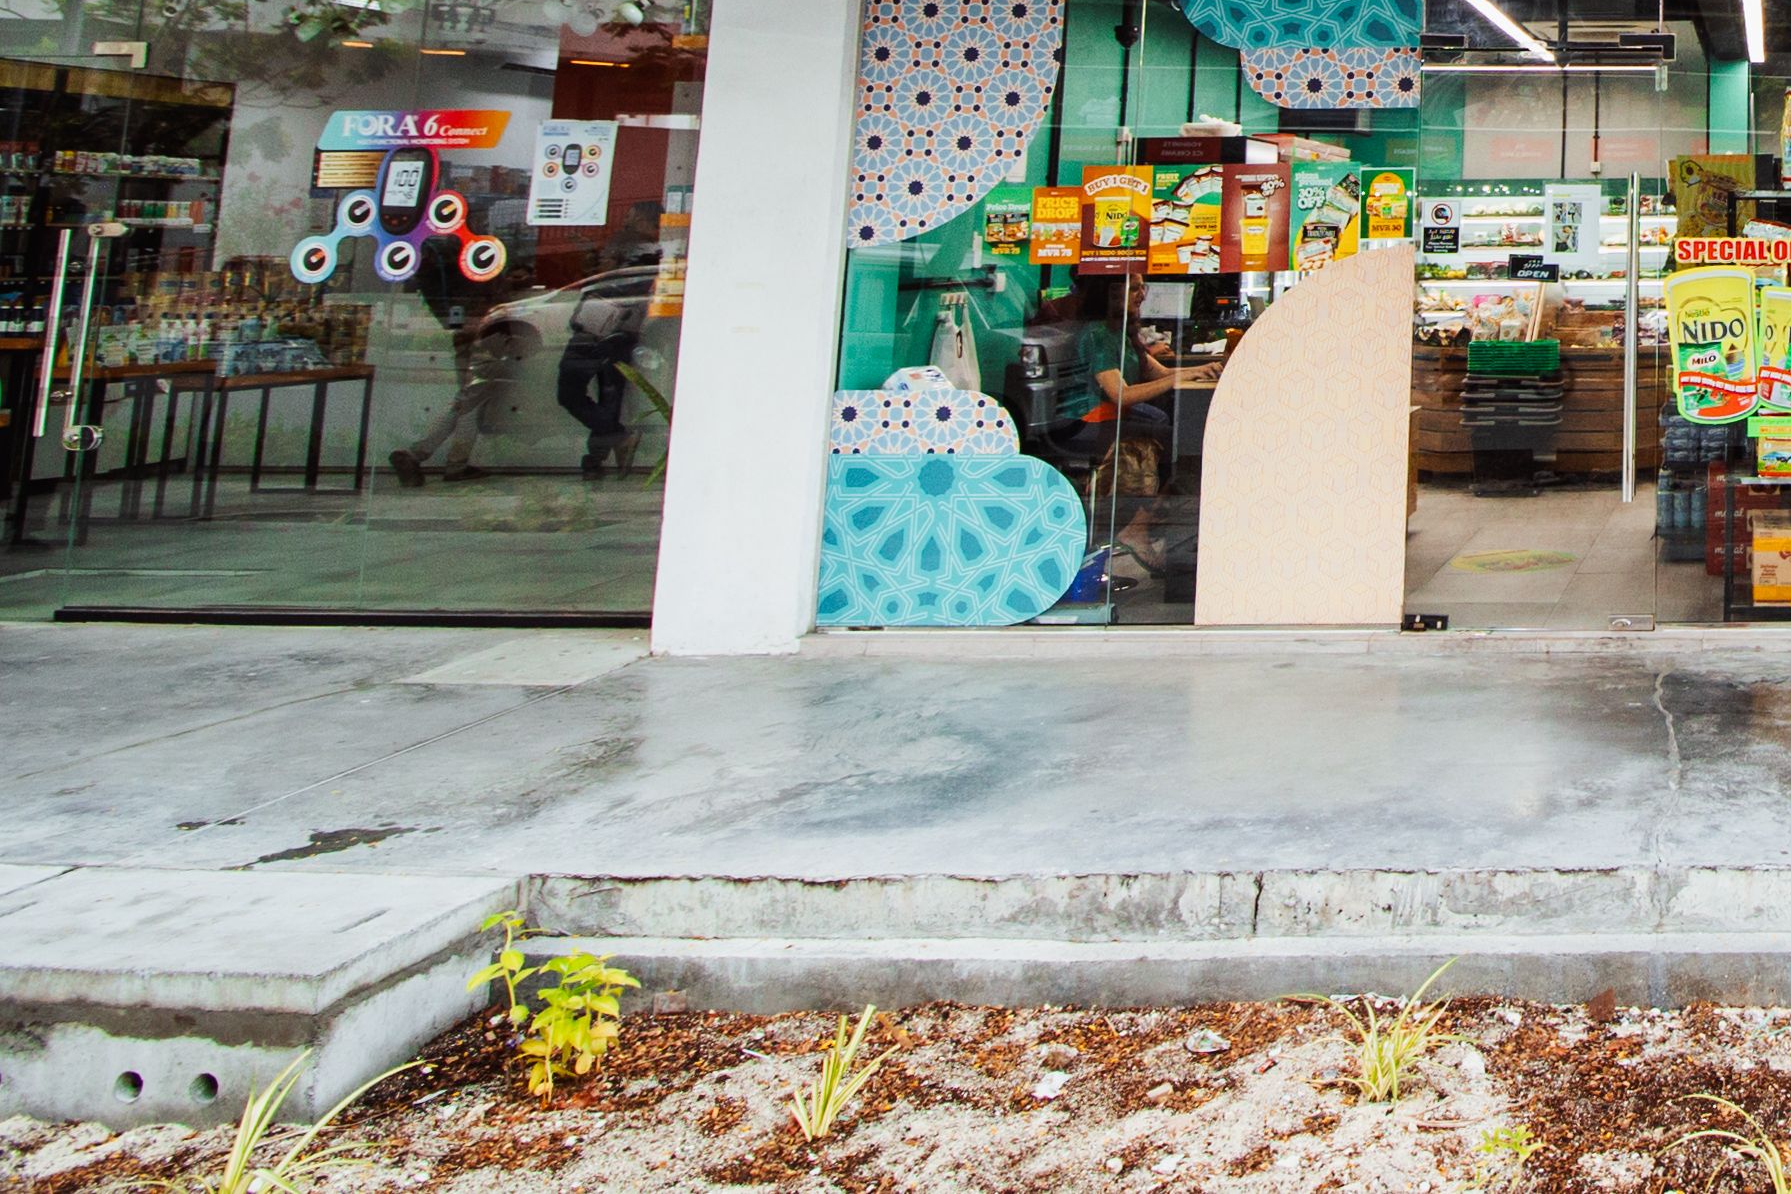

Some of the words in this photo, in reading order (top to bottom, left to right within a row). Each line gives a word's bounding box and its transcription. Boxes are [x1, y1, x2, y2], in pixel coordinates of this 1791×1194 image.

[423, 114, 441, 136] 6
[439, 125, 488, 137] Connect
[1037, 197, 1079, 208] PRICE
[1037, 208, 1079, 219] DROP!
[1677, 240, 1768, 261] SPECIAL
[1517, 269, 1550, 279] OPEN
[1682, 318, 1745, 344] NIDO
[1691, 354, 1717, 366] MILO
